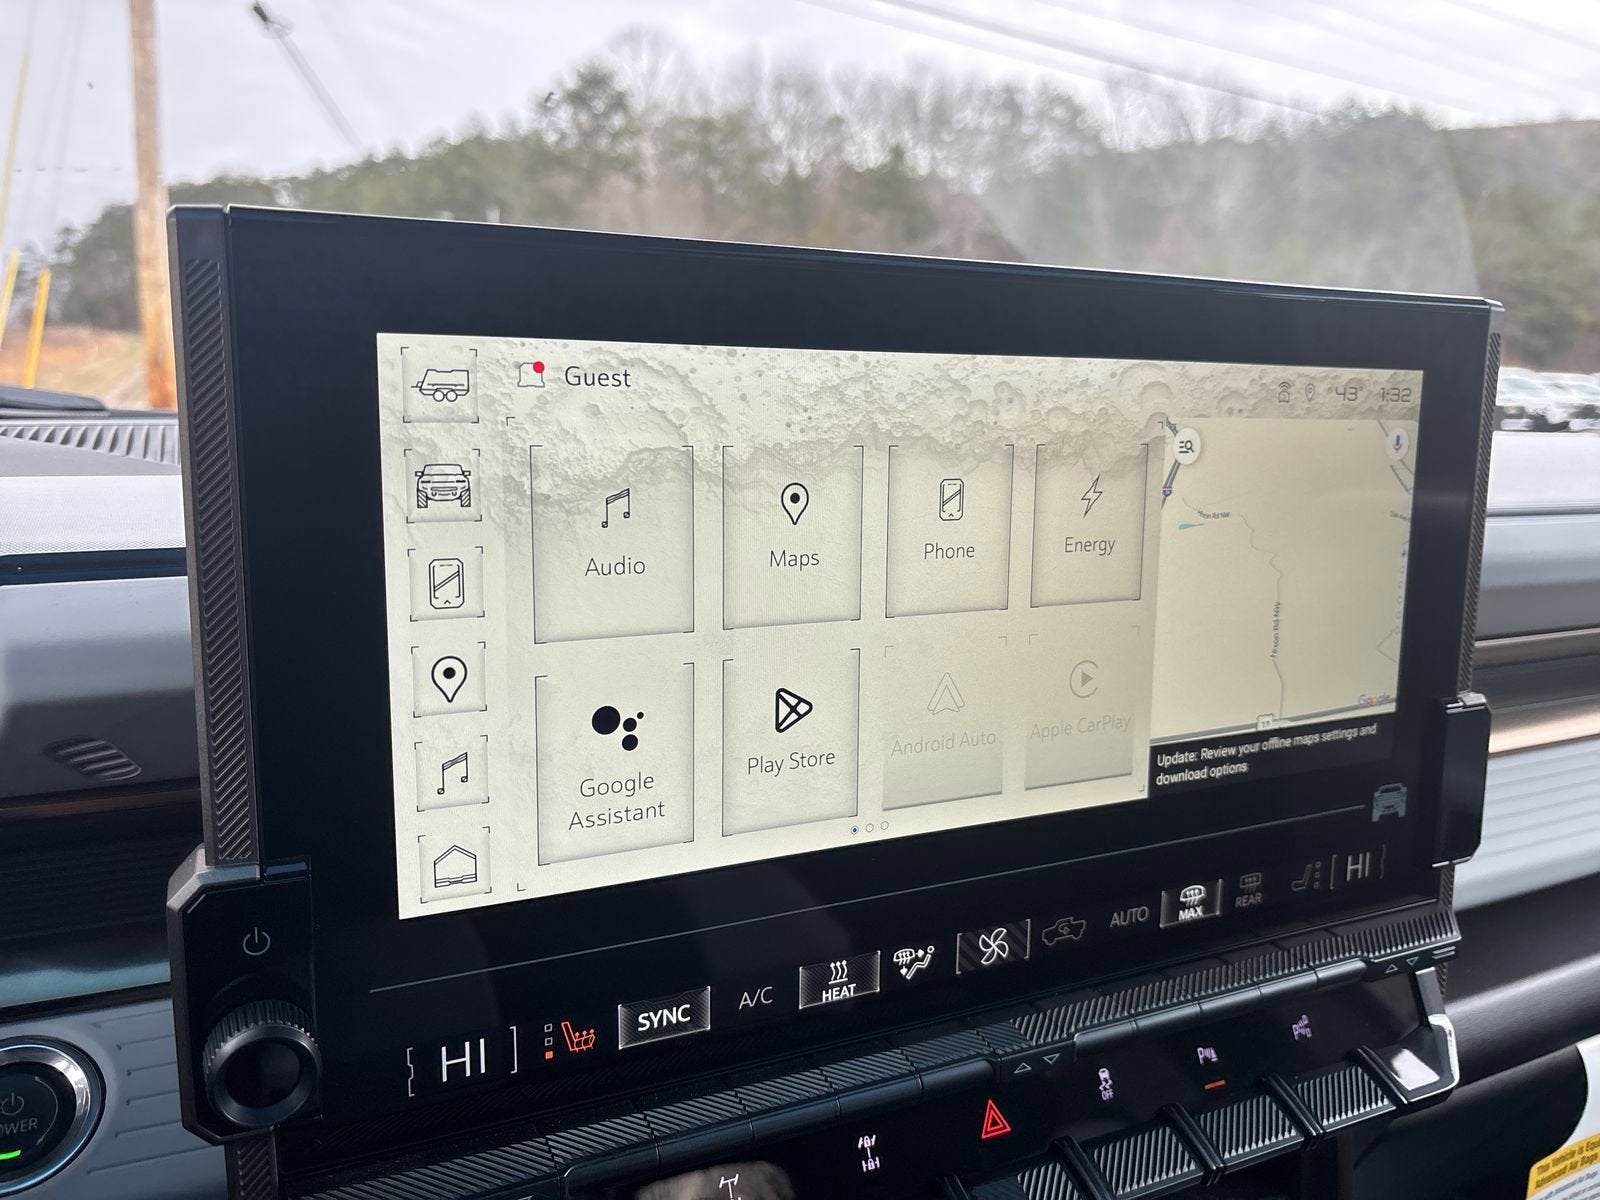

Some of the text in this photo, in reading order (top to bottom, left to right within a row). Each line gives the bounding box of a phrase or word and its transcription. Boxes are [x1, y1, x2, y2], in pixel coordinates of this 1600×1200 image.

[564, 365, 632, 388] Guest
[1379, 387, 1413, 403] 1:32
[923, 542, 976, 560] Phone
[1064, 536, 1116, 556] Energy
[584, 556, 647, 577] Audio
[769, 549, 821, 572] Maps
[1029, 713, 1132, 743] Apple CarPlay
[891, 729, 998, 757] Android Auto
[1157, 723, 1378, 768] Update: Review your offline maps settings and
[747, 751, 836, 778] Play Store
[1155, 761, 1250, 786] download options
[579, 771, 655, 798] Google
[568, 801, 666, 831] Assistant
[1346, 851, 1371, 882] HI
[1234, 892, 1262, 908] REAR
[1109, 905, 1149, 928] AUTO
[1178, 905, 1203, 921] MAX
[738, 986, 774, 1010] A/C
[821, 983, 857, 1003] HEAT
[637, 1004, 691, 1032] SYNC
[441, 1038, 487, 1083] HI
